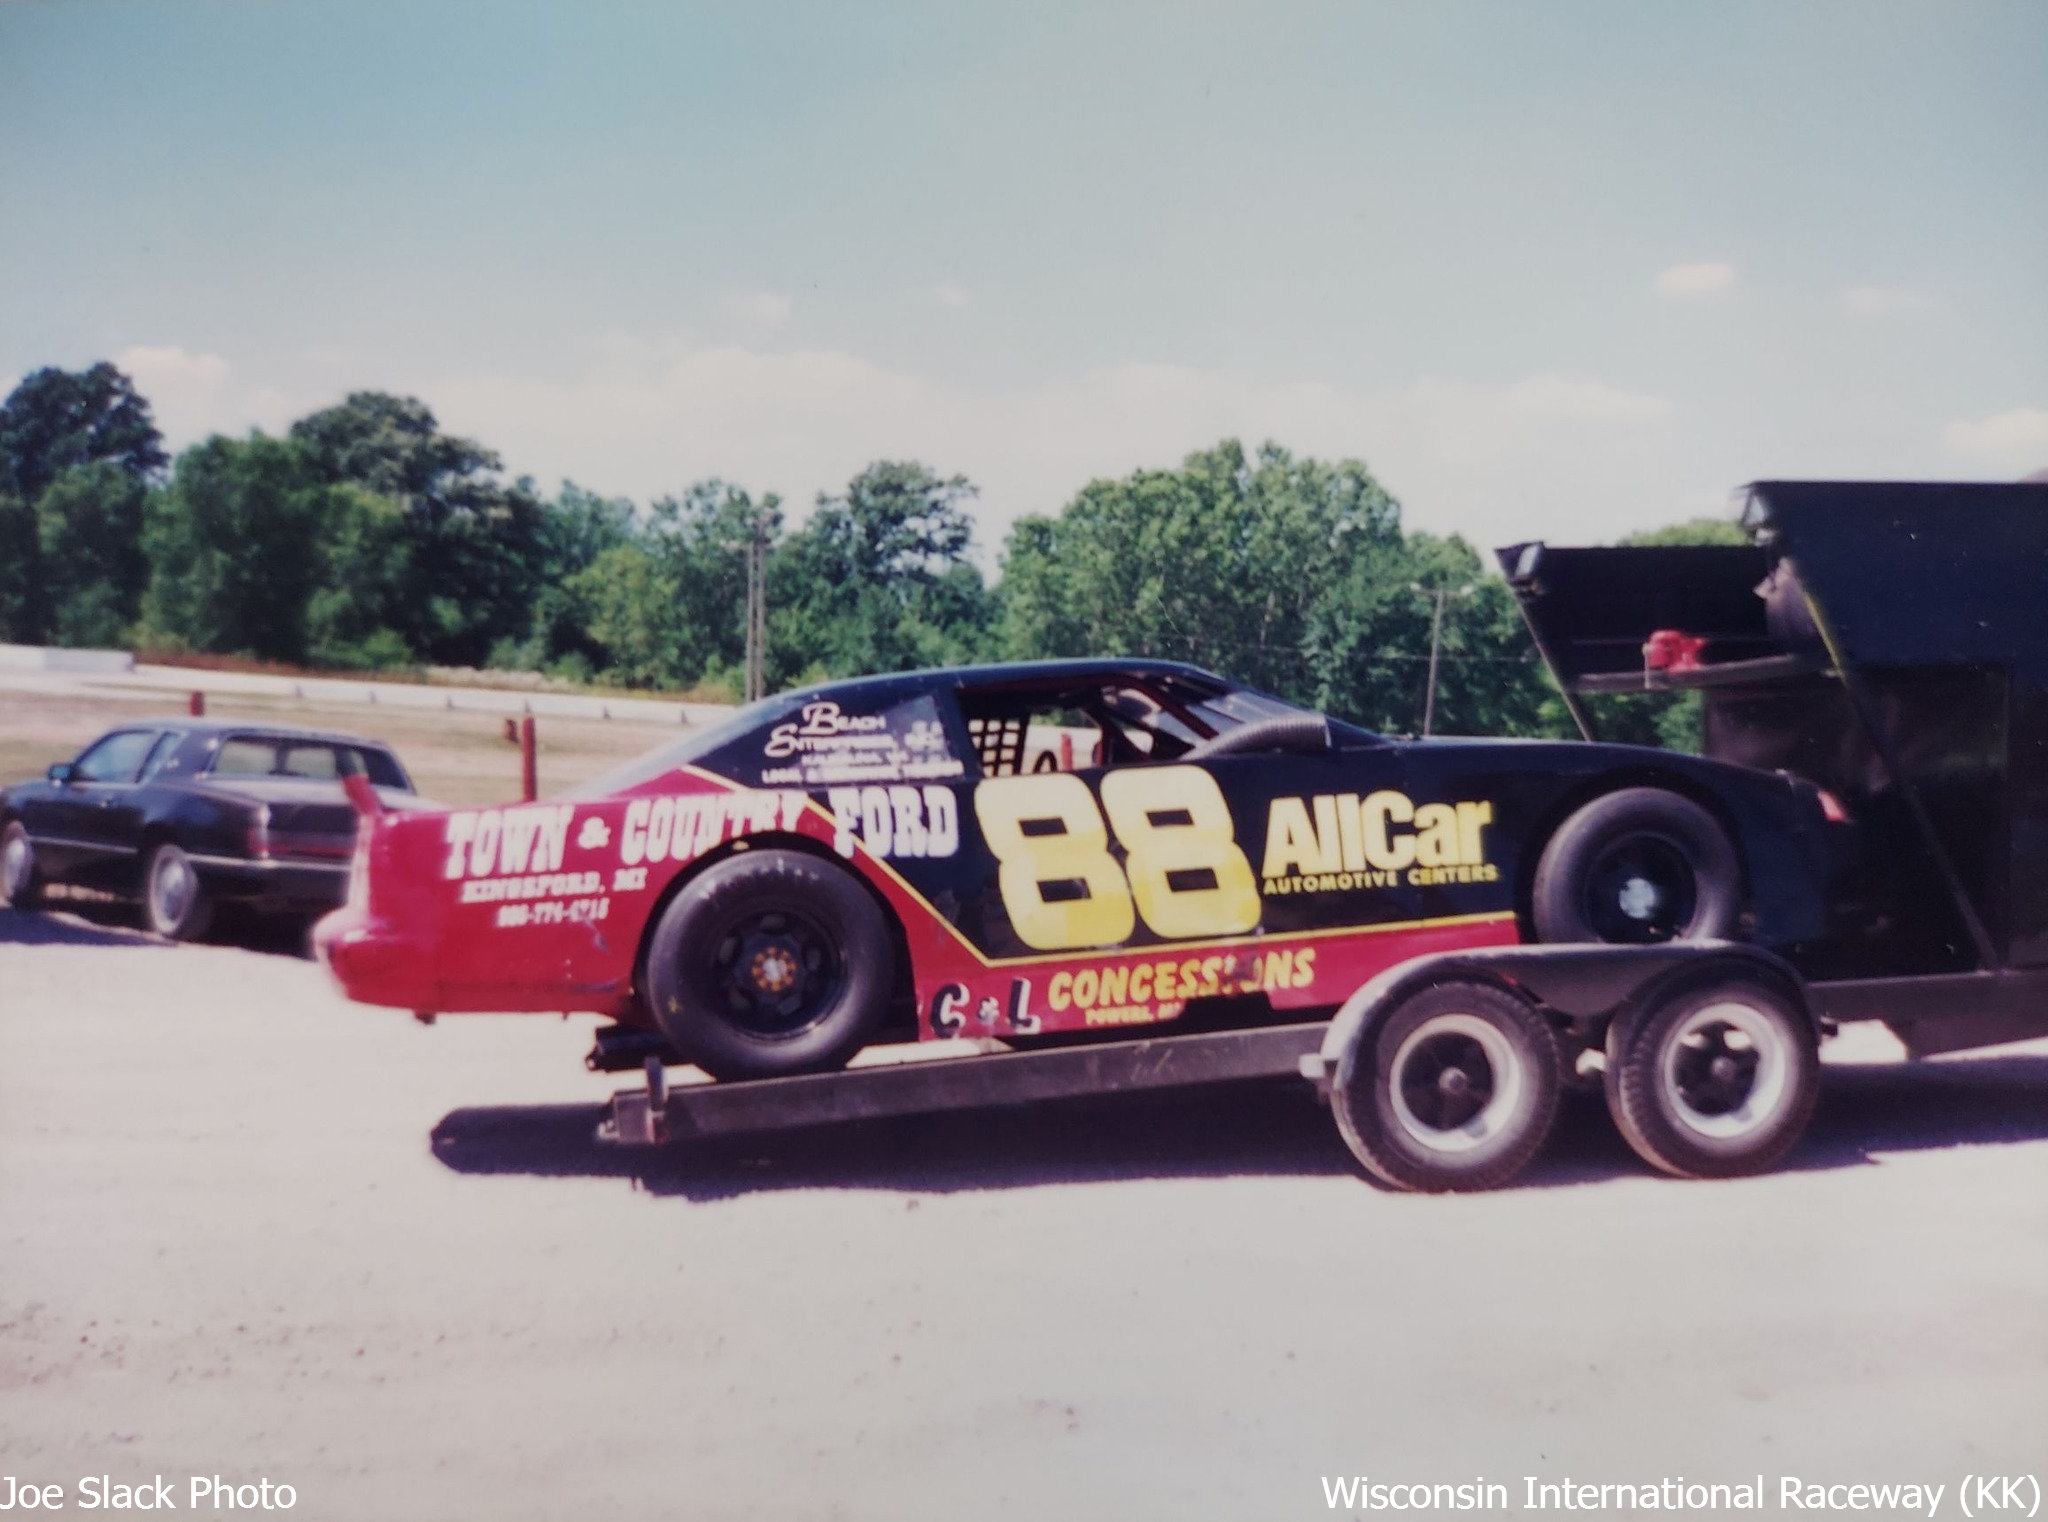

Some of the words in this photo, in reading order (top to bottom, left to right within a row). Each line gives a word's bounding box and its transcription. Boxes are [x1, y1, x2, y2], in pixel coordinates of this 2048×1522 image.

[445, 806, 574, 879] TOWN
[577, 817, 611, 850] &
[620, 789, 809, 866] COUNTRY
[828, 784, 960, 859] FORD
[973, 764, 1263, 951] 88
[1262, 790, 1492, 878] AllCar
[1262, 869, 1399, 896] AUTOMOTIVE
[1408, 863, 1499, 886] CENTERS
[929, 982, 970, 1040] C
[1005, 977, 1041, 1035] L
